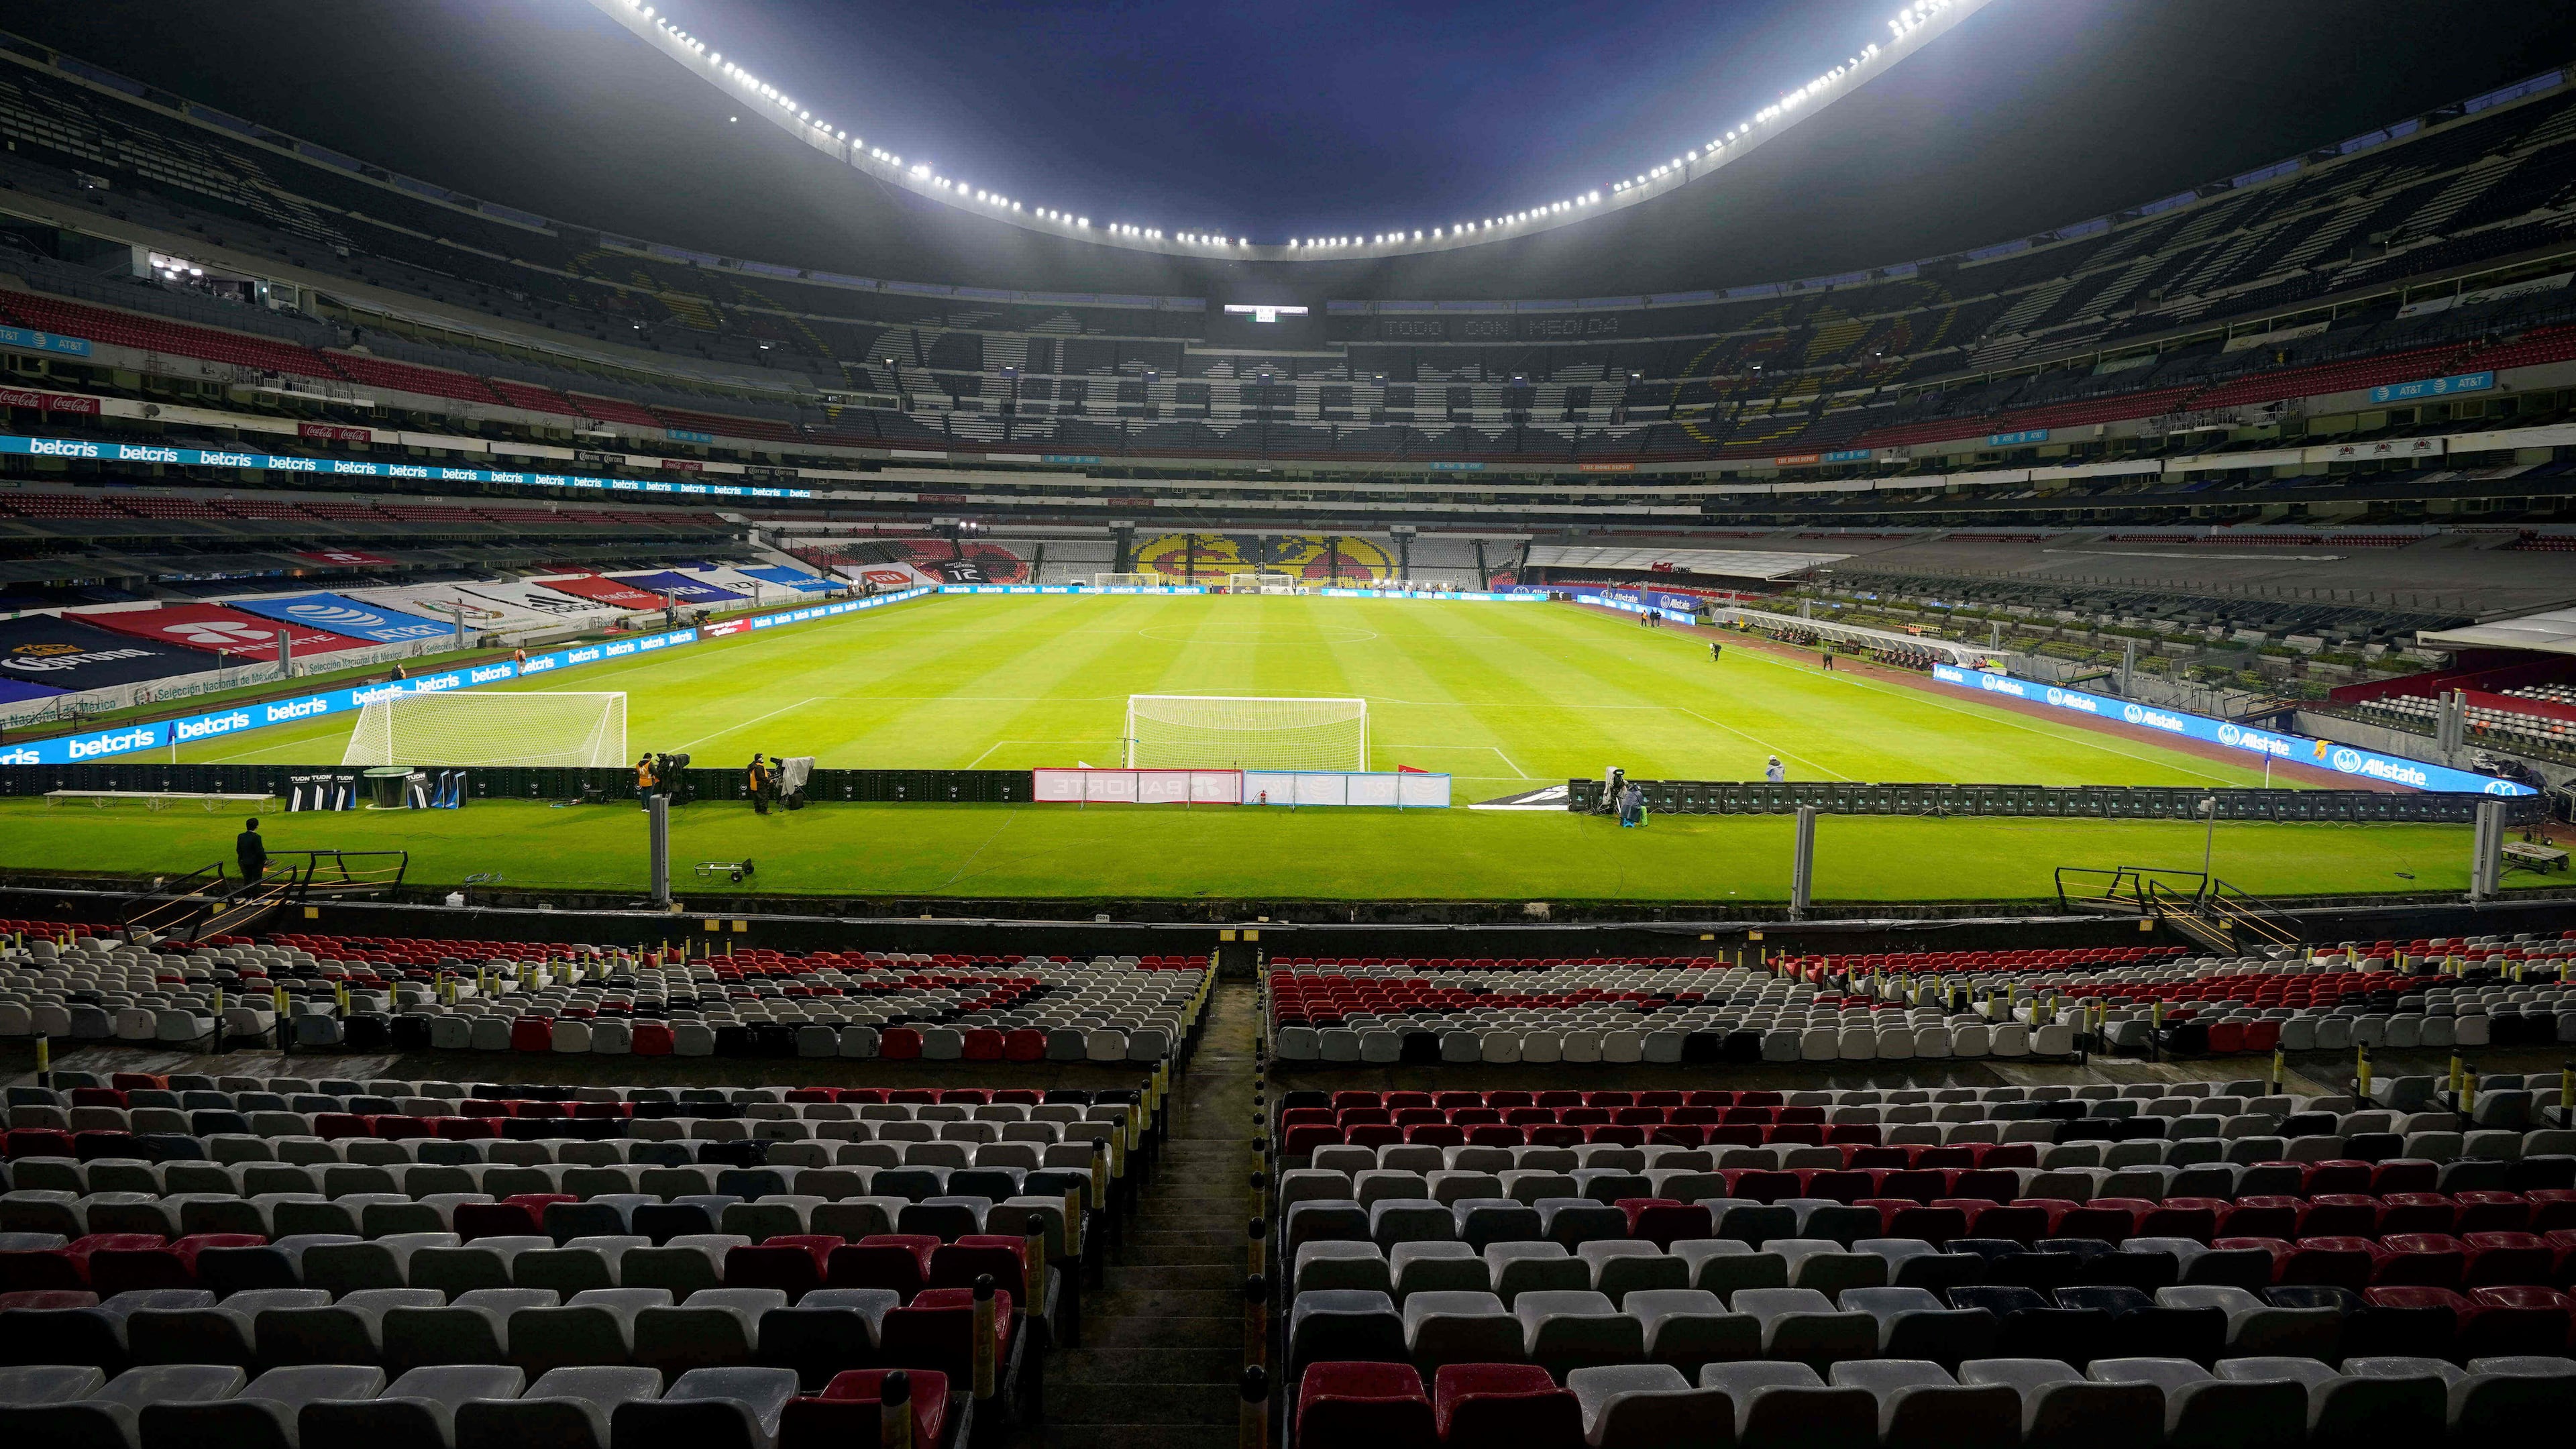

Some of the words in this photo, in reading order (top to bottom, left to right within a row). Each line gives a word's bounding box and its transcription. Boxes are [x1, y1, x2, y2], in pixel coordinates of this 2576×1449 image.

[58, 341, 83, 352] AT&T
[2458, 376, 2483, 388] AT&T
[2400, 384, 2422, 396] AT&T
[30, 437, 98, 458] betcris
[119, 444, 178, 462] betcris
[201, 450, 252, 467] betcris
[269, 455, 316, 471] betcris
[579, 451, 599, 462] Corona
[604, 453, 623, 464] Corona
[334, 460, 376, 475] betcris
[389, 464, 427, 478] betcris
[749, 466, 769, 475] Corona
[775, 469, 795, 477] Corona
[442, 468, 477, 481] betcris
[491, 471, 523, 484] betcris
[535, 474, 565, 486] betcris
[574, 476, 602, 488] betcris
[612, 479, 638, 490] betcris
[646, 481, 672, 492] betcris
[680, 484, 706, 494] betcris
[714, 485, 742, 495] betcris
[752, 487, 781, 496] betcris
[949, 568, 981, 581] 12
[652, 586, 715, 596] VISA
[1613, 593, 1638, 604] Allstate
[1669, 599, 1690, 610] Allstate
[754, 617, 771, 628] betcris
[775, 614, 792, 625] betcris
[366, 624, 447, 641] AT&T
[670, 631, 692, 644] betcris
[426, 643, 452, 653] Selección
[606, 641, 634, 655] betcris
[641, 637, 665, 649] betcris
[1, 648, 156, 672] Corona
[309, 661, 341, 673] Selección
[343, 656, 370, 668] Nacional
[372, 653, 379, 663] de
[380, 651, 402, 662] México
[569, 648, 599, 663] betcris
[472, 663, 511, 683] betcris
[1936, 667, 1963, 683] Allstate
[158, 682, 201, 700] Selección
[203, 679, 239, 693] Nacional
[240, 676, 250, 686] de
[252, 671, 279, 683] México
[416, 674, 460, 692] betcris
[1995, 679, 2024, 696] Allstate
[80, 698, 116, 713] México
[267, 697, 327, 722] betcris
[2062, 694, 2097, 712] Allstate
[178, 711, 250, 739] betcris
[2142, 711, 2184, 732] Allstate
[70, 729, 154, 759] betcris
[2239, 732, 2290, 756] Allstate
[0, 748, 40, 765] ris
[405, 772, 425, 781] TUDN
[2361, 758, 2426, 786] Allstate
[1030, 1247, 1041, 1283] 118
